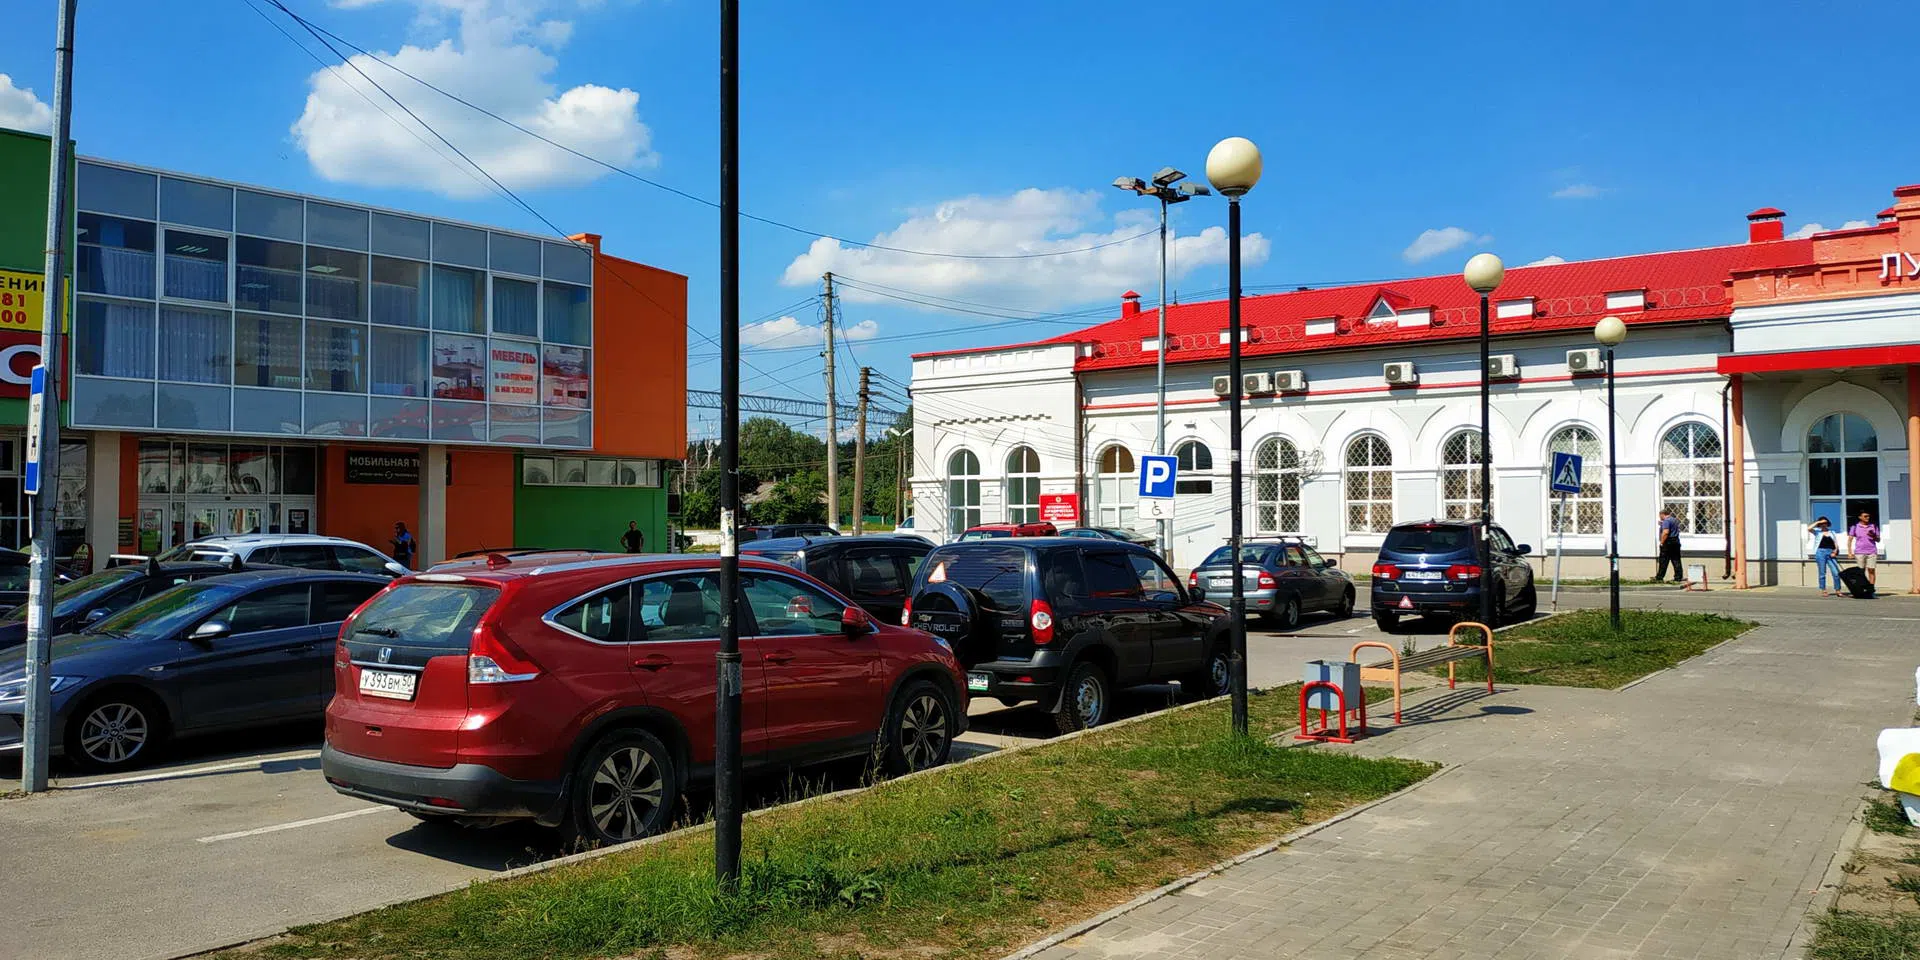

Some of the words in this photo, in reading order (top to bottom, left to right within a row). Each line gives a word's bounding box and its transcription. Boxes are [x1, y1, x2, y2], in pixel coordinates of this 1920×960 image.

[492, 350, 536, 364] МЕБЕЛЬ
[349, 457, 410, 467] МОБИЛЬНАЯ
[1145, 460, 1170, 493] P
[913, 622, 960, 632] CHEVROLET
